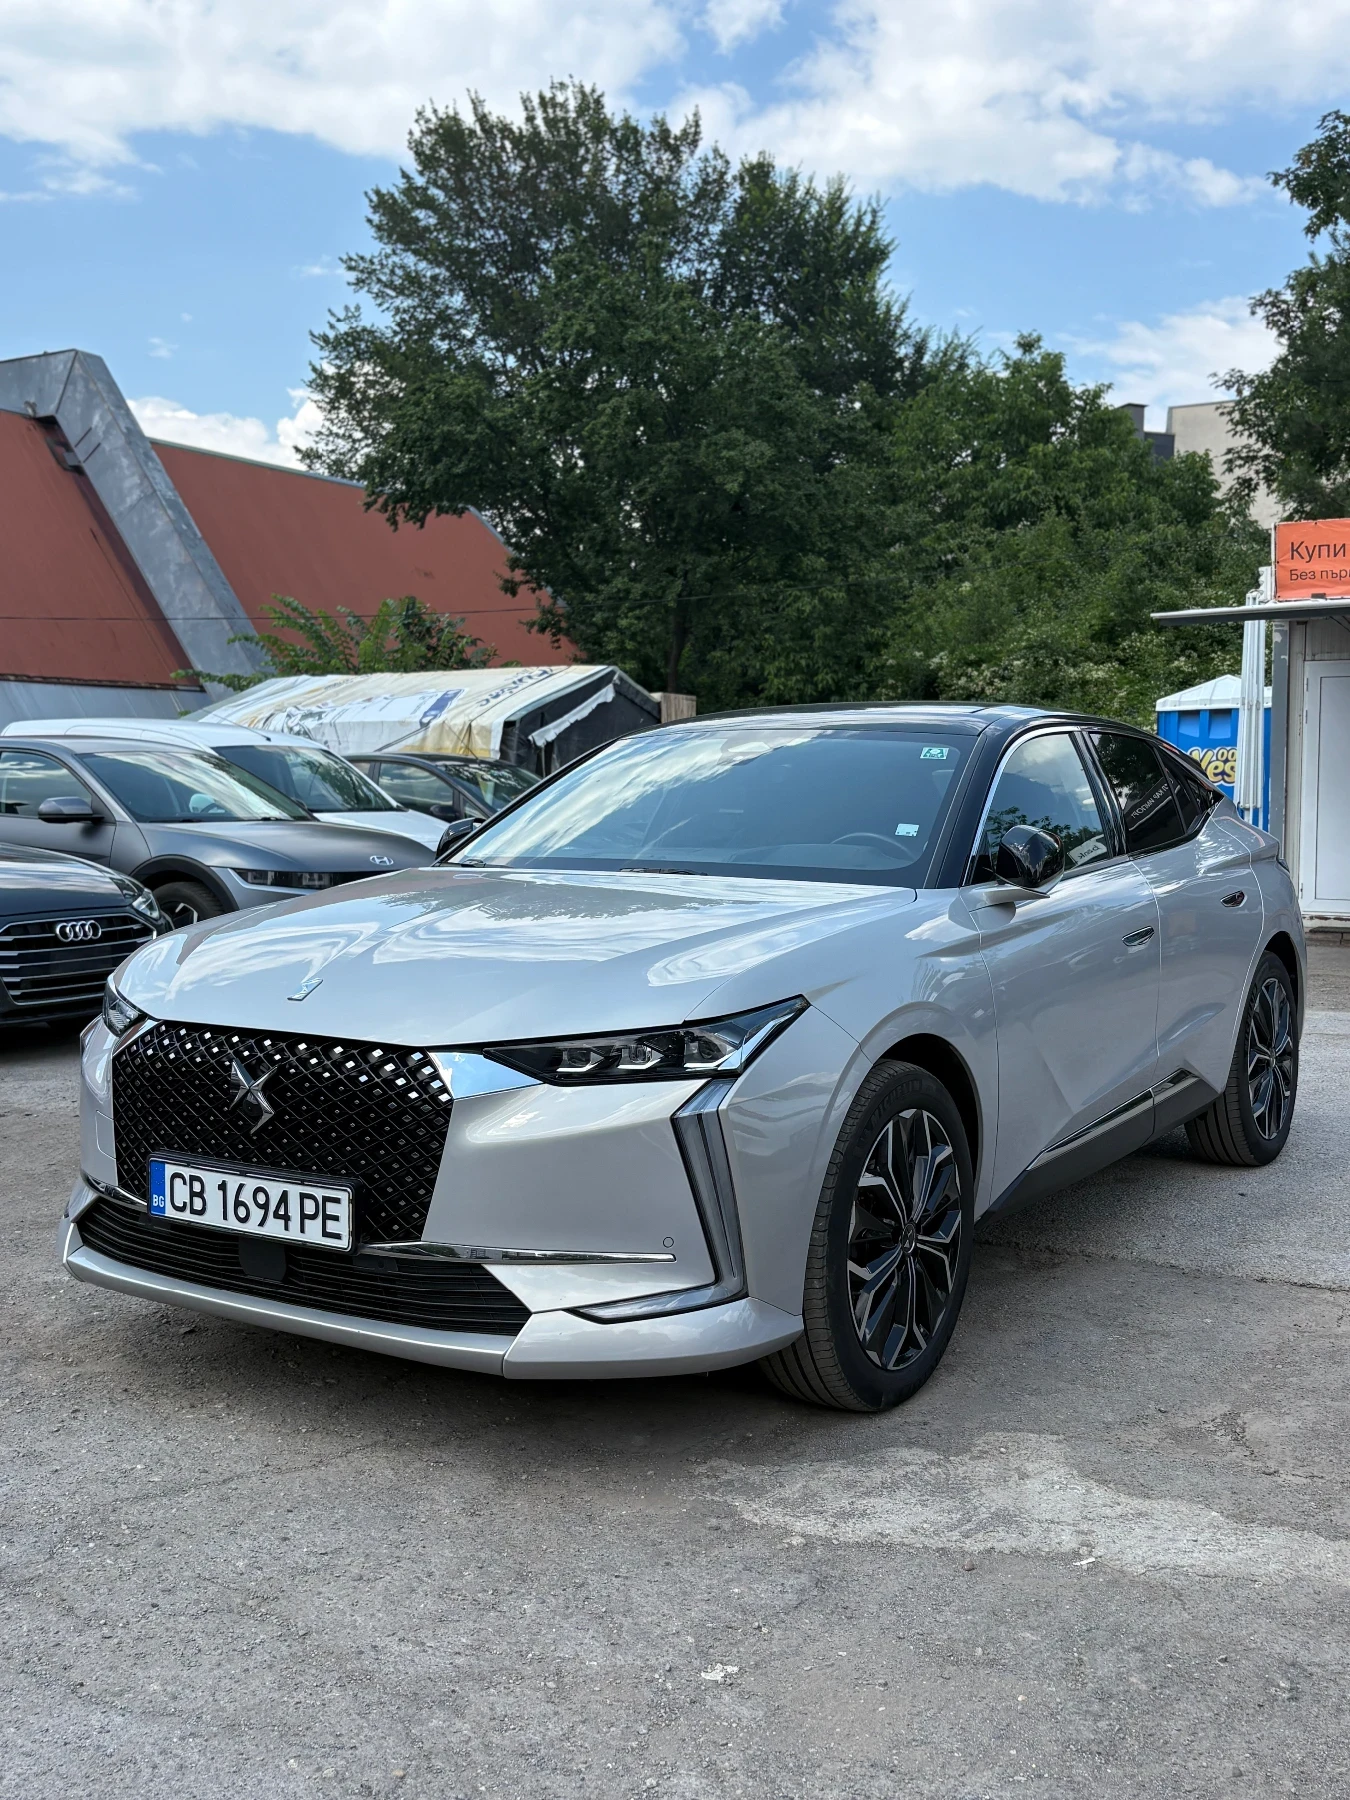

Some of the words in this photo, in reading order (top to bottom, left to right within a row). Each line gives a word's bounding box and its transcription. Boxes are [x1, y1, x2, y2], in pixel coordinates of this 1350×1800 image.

[1291, 541, 1346, 563] Купи
[1290, 569, 1316, 581] Без
[1321, 568, 1350, 581] пър
[152, 1194, 165, 1208] BG
[169, 1171, 208, 1217] CB
[217, 1179, 292, 1233] 1694
[298, 1191, 343, 1241] PE
